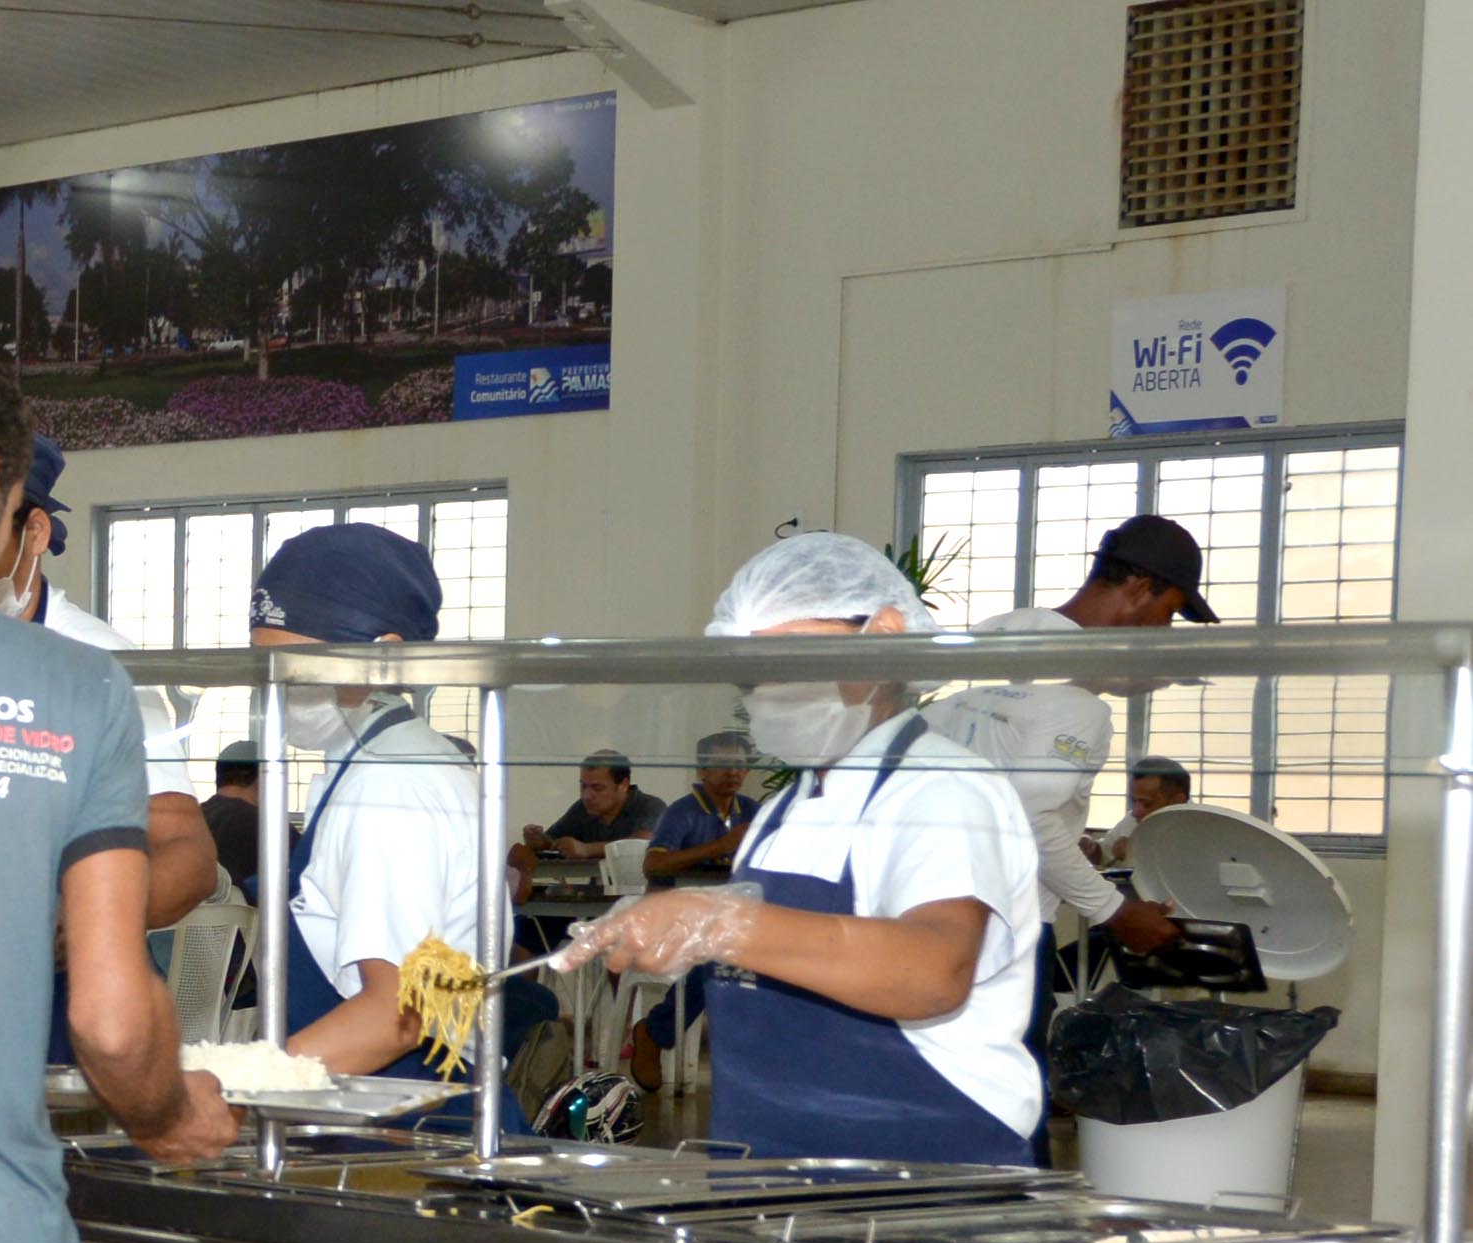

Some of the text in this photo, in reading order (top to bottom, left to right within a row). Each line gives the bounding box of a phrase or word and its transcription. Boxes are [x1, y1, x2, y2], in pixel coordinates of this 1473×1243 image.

[1178, 319, 1202, 331] Rede
[1133, 333, 1203, 369] Wi-Fi
[475, 371, 527, 385] Restaurante
[1132, 367, 1201, 393] ABERTA
[470, 388, 527, 403] Comunitário
[21, 727, 75, 753] VIDRO
